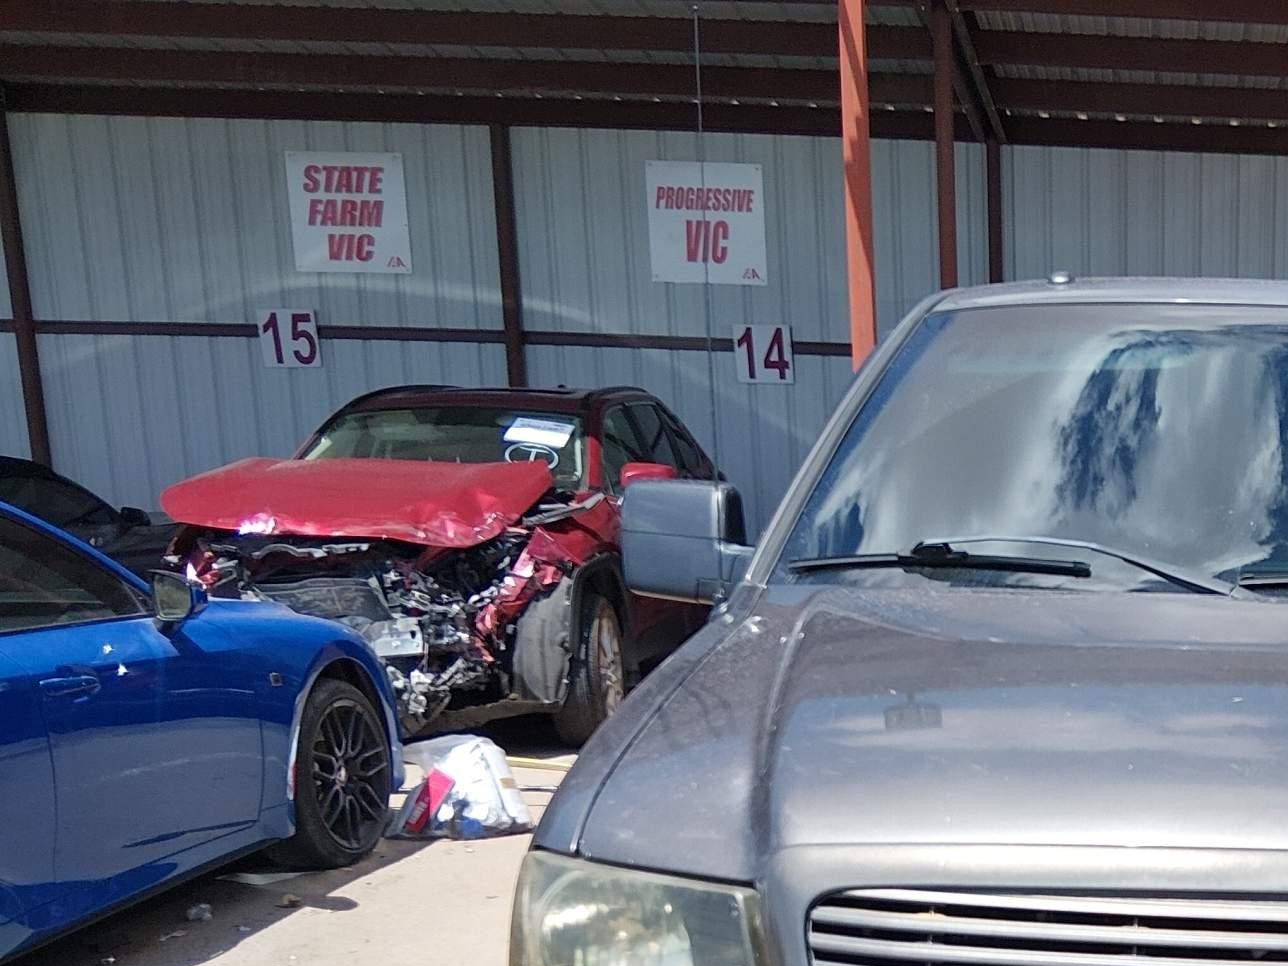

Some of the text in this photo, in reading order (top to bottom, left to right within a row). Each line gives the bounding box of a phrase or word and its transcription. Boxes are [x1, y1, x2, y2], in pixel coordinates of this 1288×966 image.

[303, 165, 384, 194] STATE
[308, 199, 384, 227] FARM
[656, 186, 754, 212] PROGRESSIVE
[328, 233, 375, 262] VIC
[685, 219, 729, 264] VIC
[263, 312, 316, 365] 15
[738, 327, 789, 379] 14
